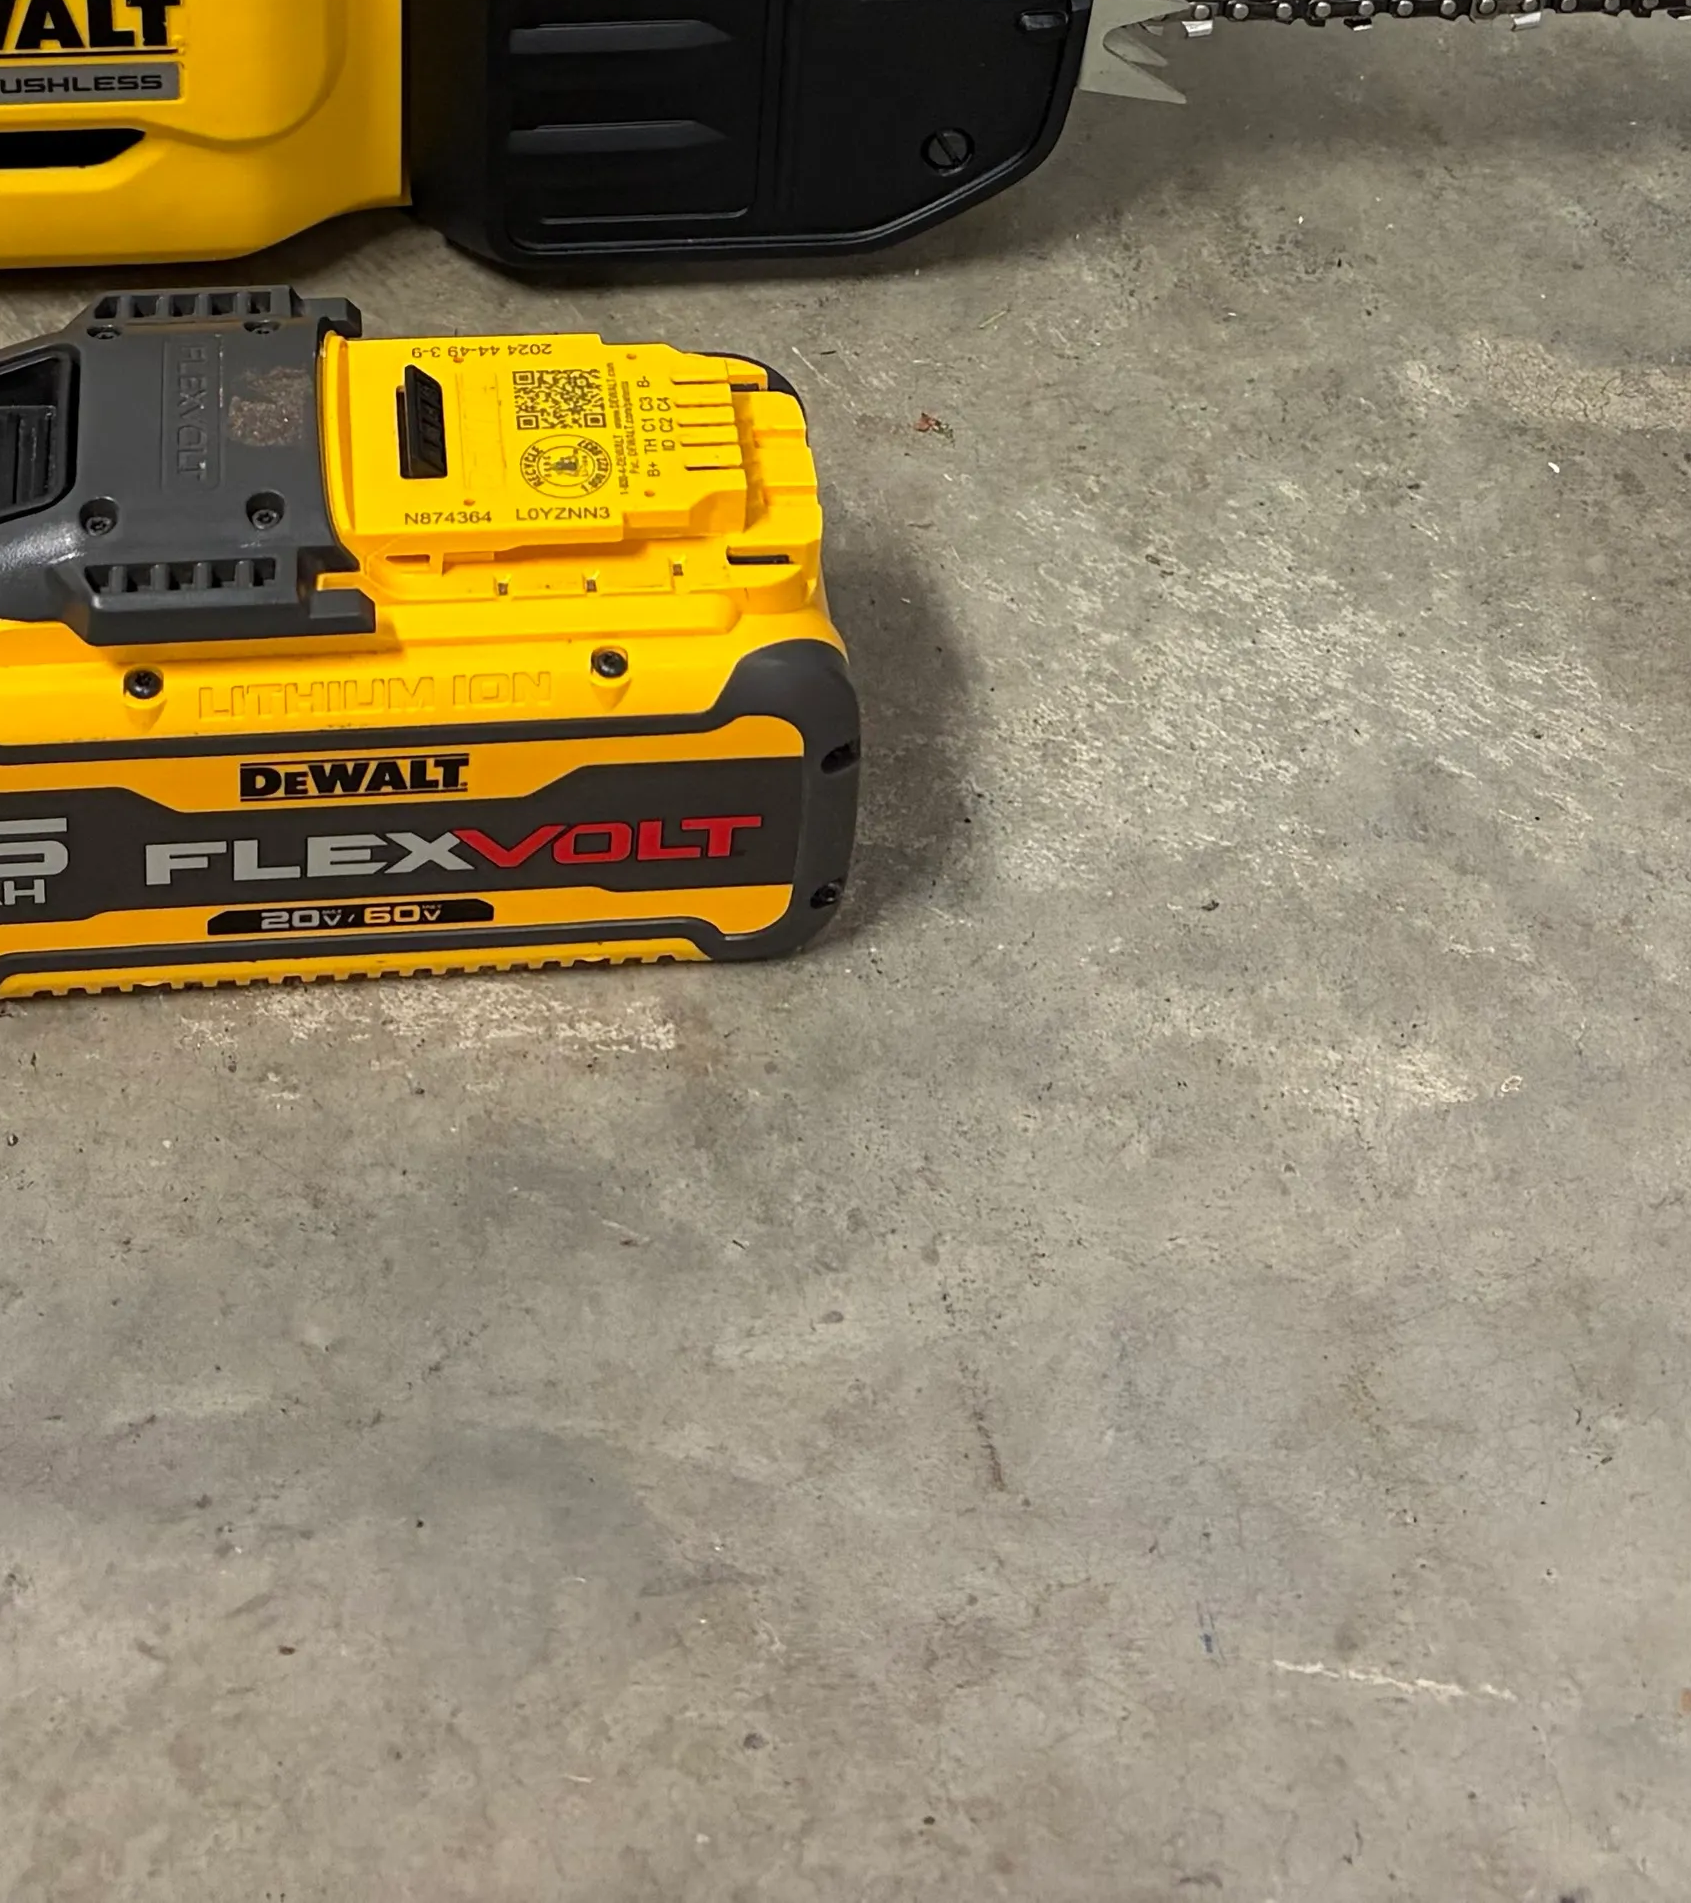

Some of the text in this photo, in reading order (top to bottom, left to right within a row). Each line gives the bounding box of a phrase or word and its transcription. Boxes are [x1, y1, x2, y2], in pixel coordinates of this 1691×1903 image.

[507, 343, 552, 355] 2024
[177, 344, 207, 481] FLEXVOLT
[637, 376, 661, 477] B+ TH C1 C3 B-
[657, 396, 675, 451] ID C2 C4
[524, 446, 545, 488] RECYCLE
[404, 511, 492, 524] N874364
[198, 670, 552, 721] LITHIUM ION
[240, 757, 469, 797] DEWALT
[146, 816, 763, 885] FLEXVOLT
